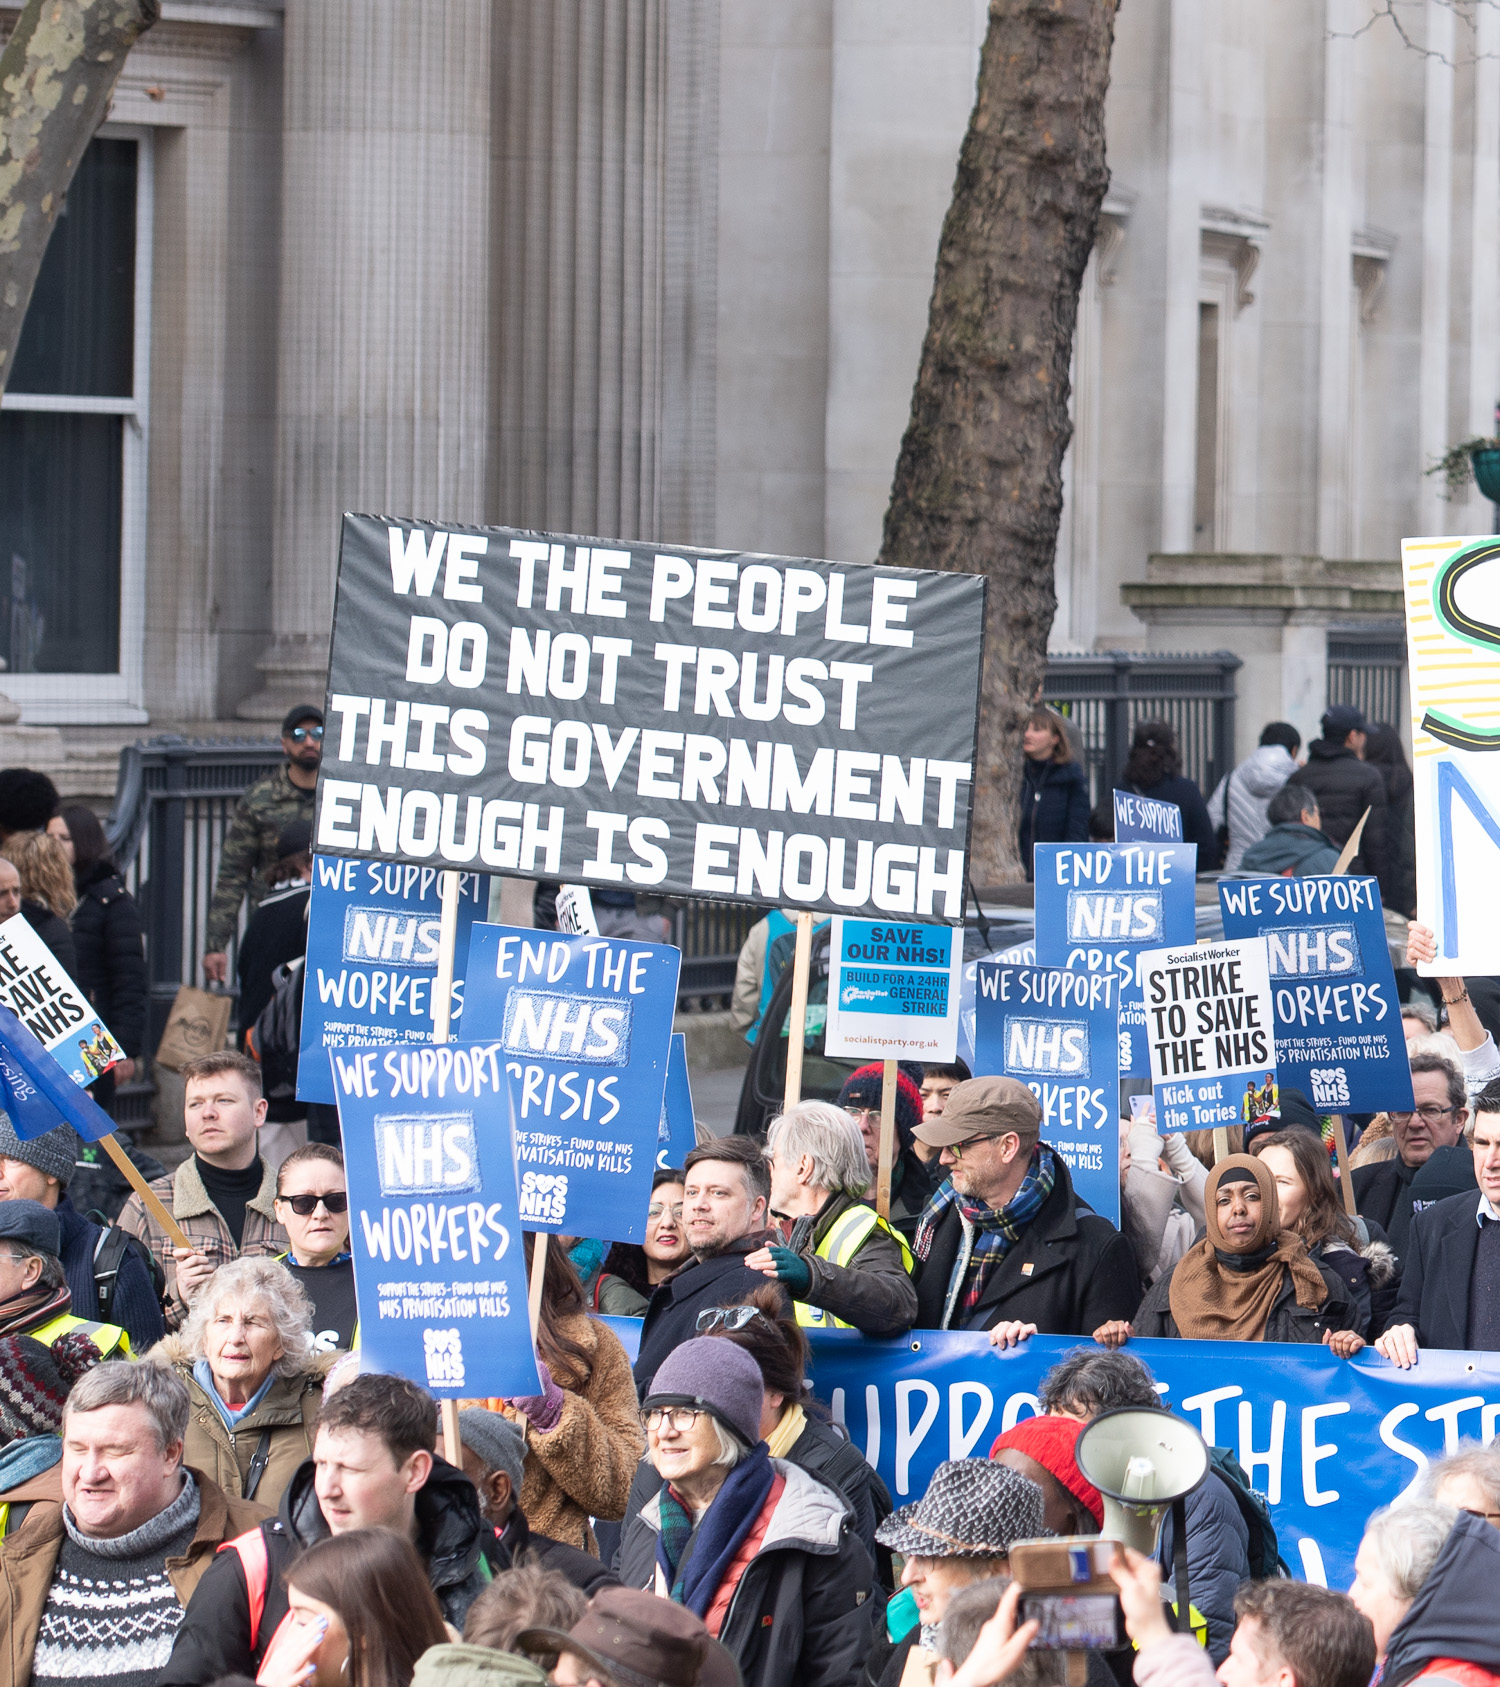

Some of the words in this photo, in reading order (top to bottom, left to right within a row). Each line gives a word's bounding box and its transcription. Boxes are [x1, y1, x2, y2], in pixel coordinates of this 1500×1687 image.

[389, 526, 488, 603] WE
[509, 540, 632, 618] THE
[649, 554, 918, 648] PEOPLE
[406, 616, 488, 689] DO
[507, 627, 633, 705] NOT
[654, 643, 874, 730] TRUST
[331, 694, 490, 776] THIS
[508, 715, 972, 829] GOVERNMENT
[1116, 797, 1136, 828] WE
[1137, 797, 1181, 838] SUPPORT
[319, 779, 564, 874] ENOUGH
[582, 810, 670, 885] IS
[692, 823, 966, 918] ENOUGH
[1056, 848, 1113, 886] END
[1121, 846, 1176, 886] THE
[319, 858, 361, 892] WE
[1072, 897, 1158, 939] NHS
[1223, 885, 1262, 916] WE
[1269, 878, 1376, 916] SUPPORT
[349, 913, 441, 964] NHS
[847, 943, 890, 961] OUR
[896, 946, 945, 964] NHS!
[870, 927, 923, 945] SAVE
[1267, 930, 1354, 975] NHS
[496, 936, 572, 984] END
[582, 941, 655, 995] THE
[847, 971, 880, 983] BUILD
[883, 973, 904, 985] FOR
[907, 975, 916, 985] A
[918, 975, 948, 987] 24HR
[1150, 961, 1244, 1004] STRIKE
[890, 987, 946, 1001] GENERAL
[902, 1001, 946, 1015] STRIKE
[980, 968, 1013, 1002] WE
[1018, 969, 1118, 1011] SUPPORT
[1272, 982, 1388, 1028] ORKERS
[26, 992, 85, 1046] NHS
[509, 996, 626, 1059] NHS
[1152, 1003, 1186, 1040] TO
[1196, 995, 1261, 1035] SAVE
[844, 1035, 939, 1050] socialistparty.org.uk
[1008, 1023, 1085, 1072] NHS
[1155, 1038, 1208, 1076] THE
[1215, 1029, 1268, 1069] NHS
[1288, 1046, 1361, 1064] PRIVATISATION
[1363, 1045, 1390, 1060] KILLS
[336, 1051, 379, 1099] WE
[384, 1043, 501, 1099] SUPPORT
[1163, 1084, 1195, 1107] Kick
[1198, 1081, 1224, 1100] out
[1312, 1083, 1351, 1102] NHS
[1164, 1109, 1189, 1129] the
[1192, 1105, 1237, 1125] Tories
[383, 1125, 473, 1187] NHS
[516, 1144, 595, 1170] IVATISATION
[597, 1154, 632, 1174] KILLS
[529, 1132, 562, 1147] STRIKES
[570, 1137, 594, 1151] FUND
[596, 1140, 614, 1152] OUR
[615, 1143, 633, 1155] NHS
[1079, 1154, 1104, 1171] KILLS
[519, 1192, 567, 1218] NHS
[360, 1202, 511, 1266] WORKERS
[425, 1352, 465, 1380] NHS
[1183, 1384, 1353, 1508] THE
